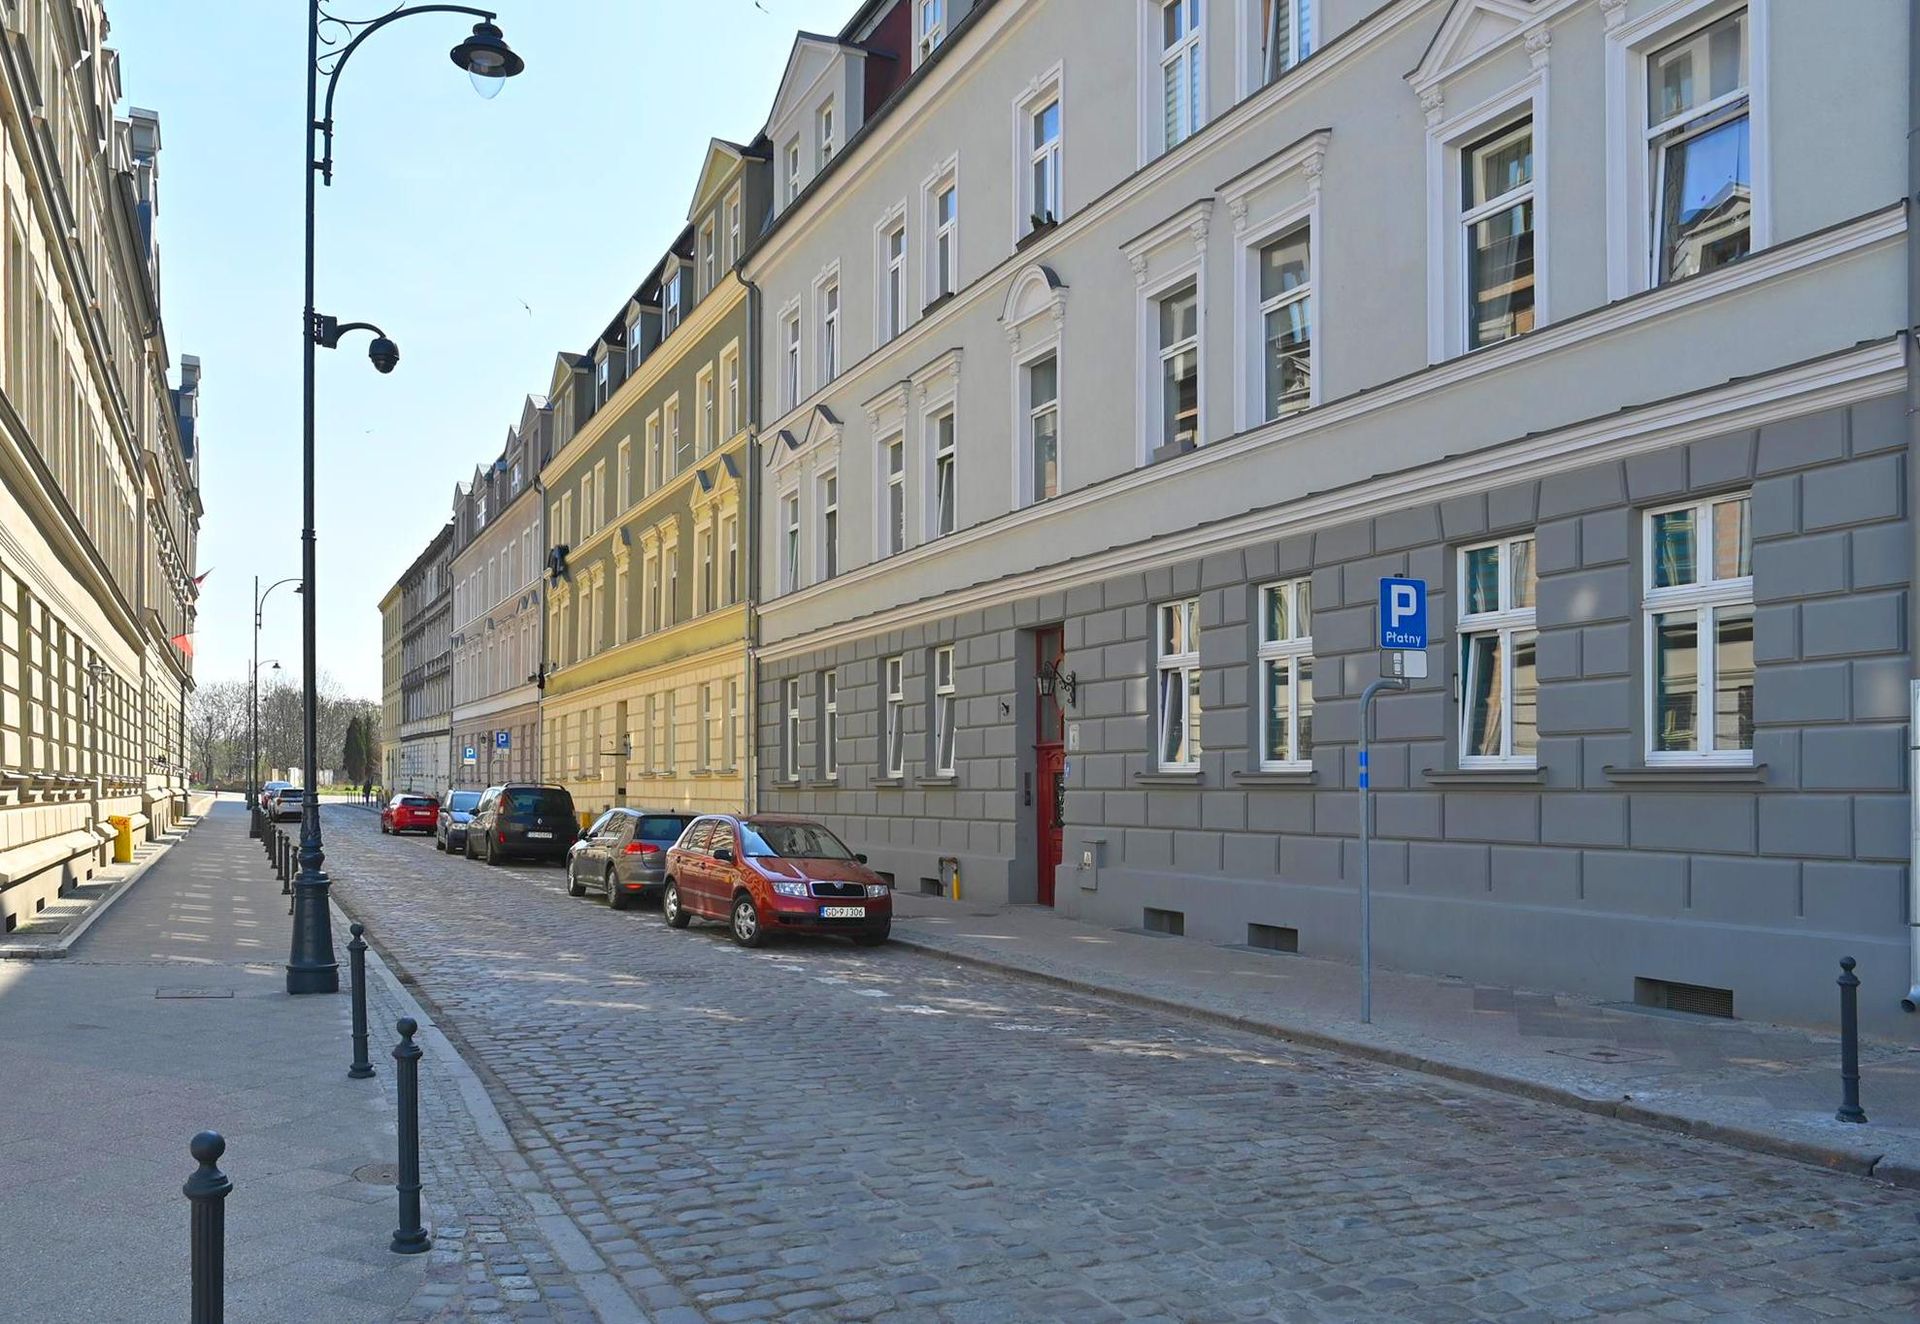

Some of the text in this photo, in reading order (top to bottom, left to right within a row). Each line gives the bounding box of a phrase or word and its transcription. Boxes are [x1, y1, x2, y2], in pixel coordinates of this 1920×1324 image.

[1391, 584, 1417, 627] P
[1386, 631, 1421, 647] Płatny
[498, 733, 507, 744] P
[466, 747, 474, 758] P
